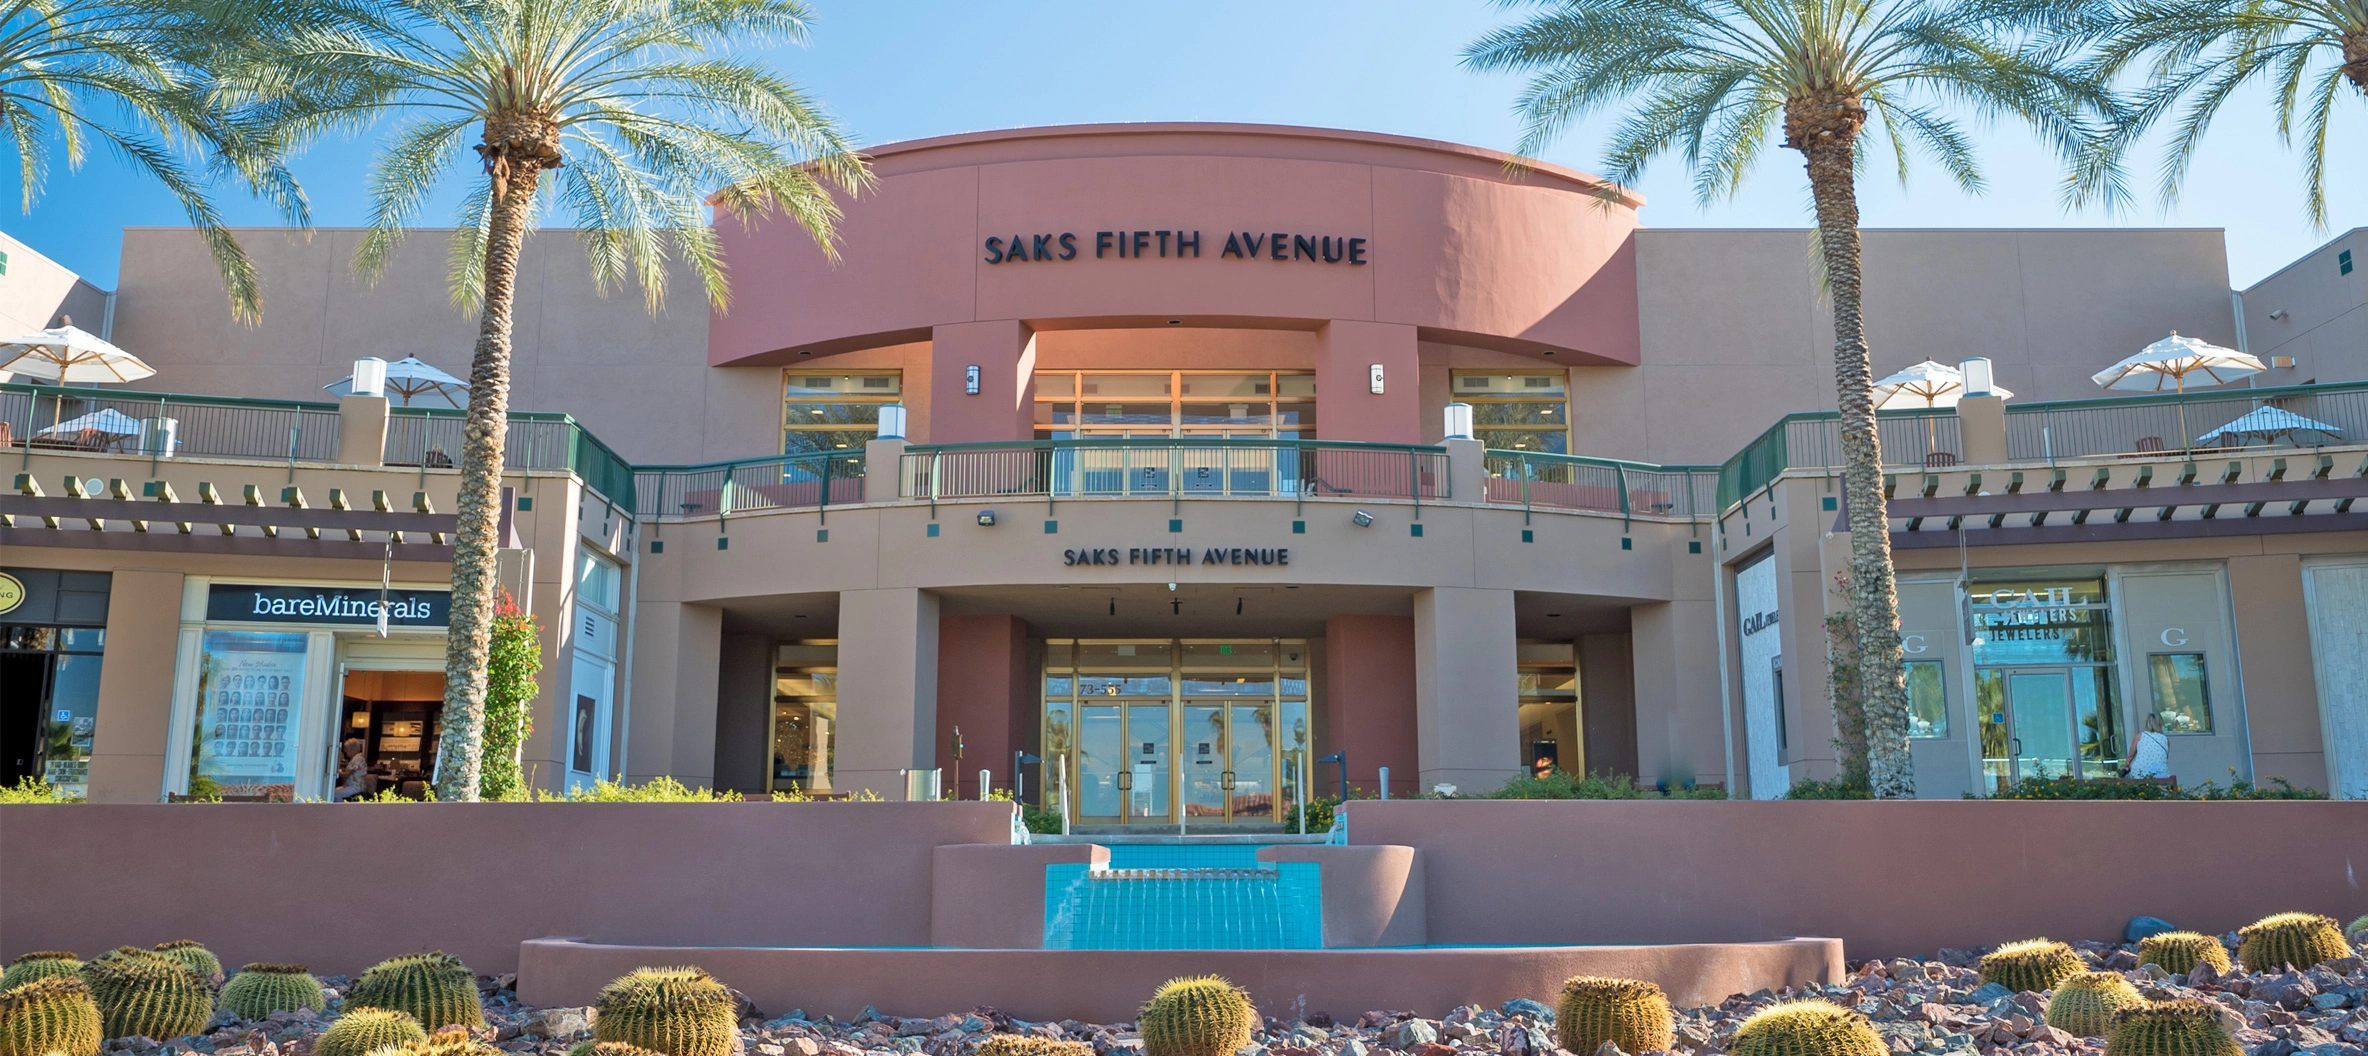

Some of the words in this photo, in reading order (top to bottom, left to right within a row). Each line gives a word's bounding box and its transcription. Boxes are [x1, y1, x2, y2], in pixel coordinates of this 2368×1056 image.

[984, 232, 1077, 264] SAKS
[1096, 230, 1200, 258] FIFTH
[1221, 230, 1368, 265] AVENUE
[1063, 548, 1119, 566] SAKS
[1129, 548, 1191, 566] FIFTH
[1201, 548, 1289, 566] AVENUE
[1990, 586, 2088, 609] GAIL
[1743, 612, 1764, 636] GAIL
[2003, 608, 2077, 624] JEWELERS
[1902, 635, 1928, 654] G
[2160, 627, 2189, 647] G
[1080, 684, 1122, 695] 73-555
